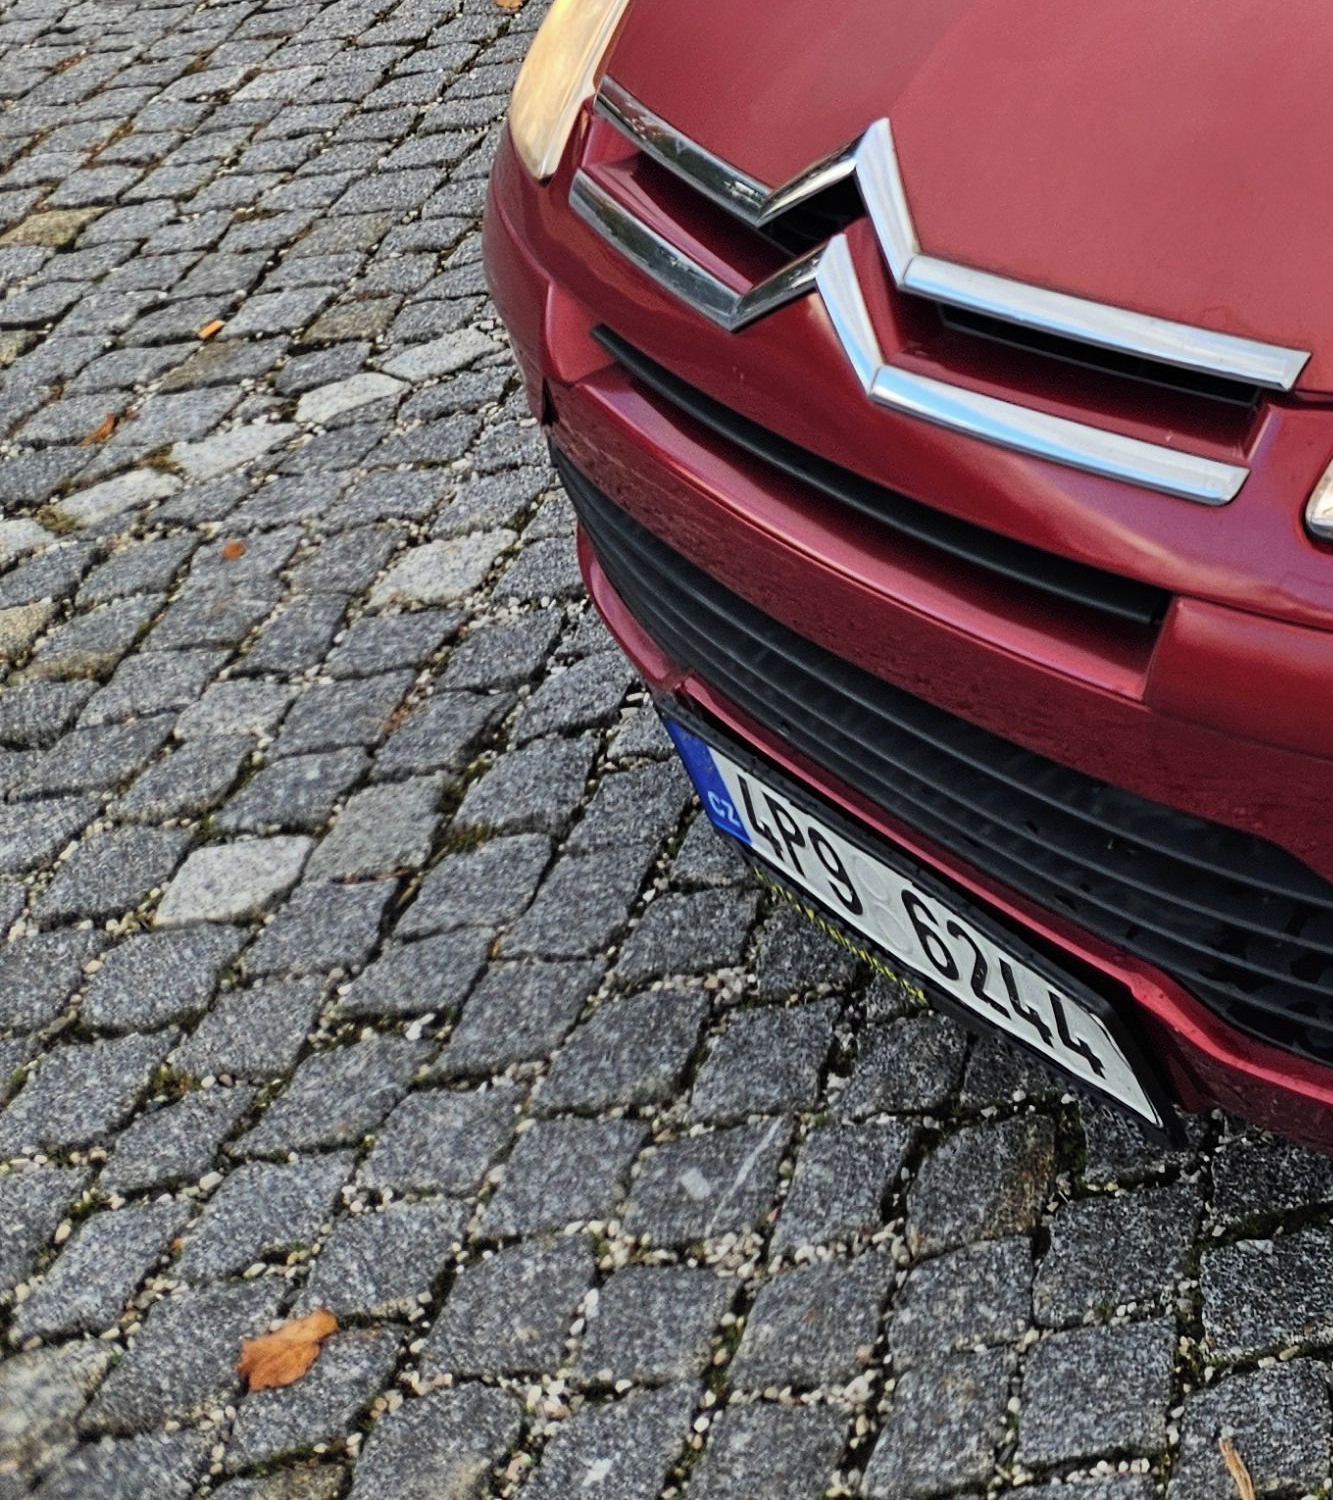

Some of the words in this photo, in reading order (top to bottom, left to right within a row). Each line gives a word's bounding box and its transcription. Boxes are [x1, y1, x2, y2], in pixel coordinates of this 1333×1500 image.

[707, 790, 741, 828] CZ
[736, 773, 864, 916] 4P9
[900, 888, 1106, 1080] 6244
